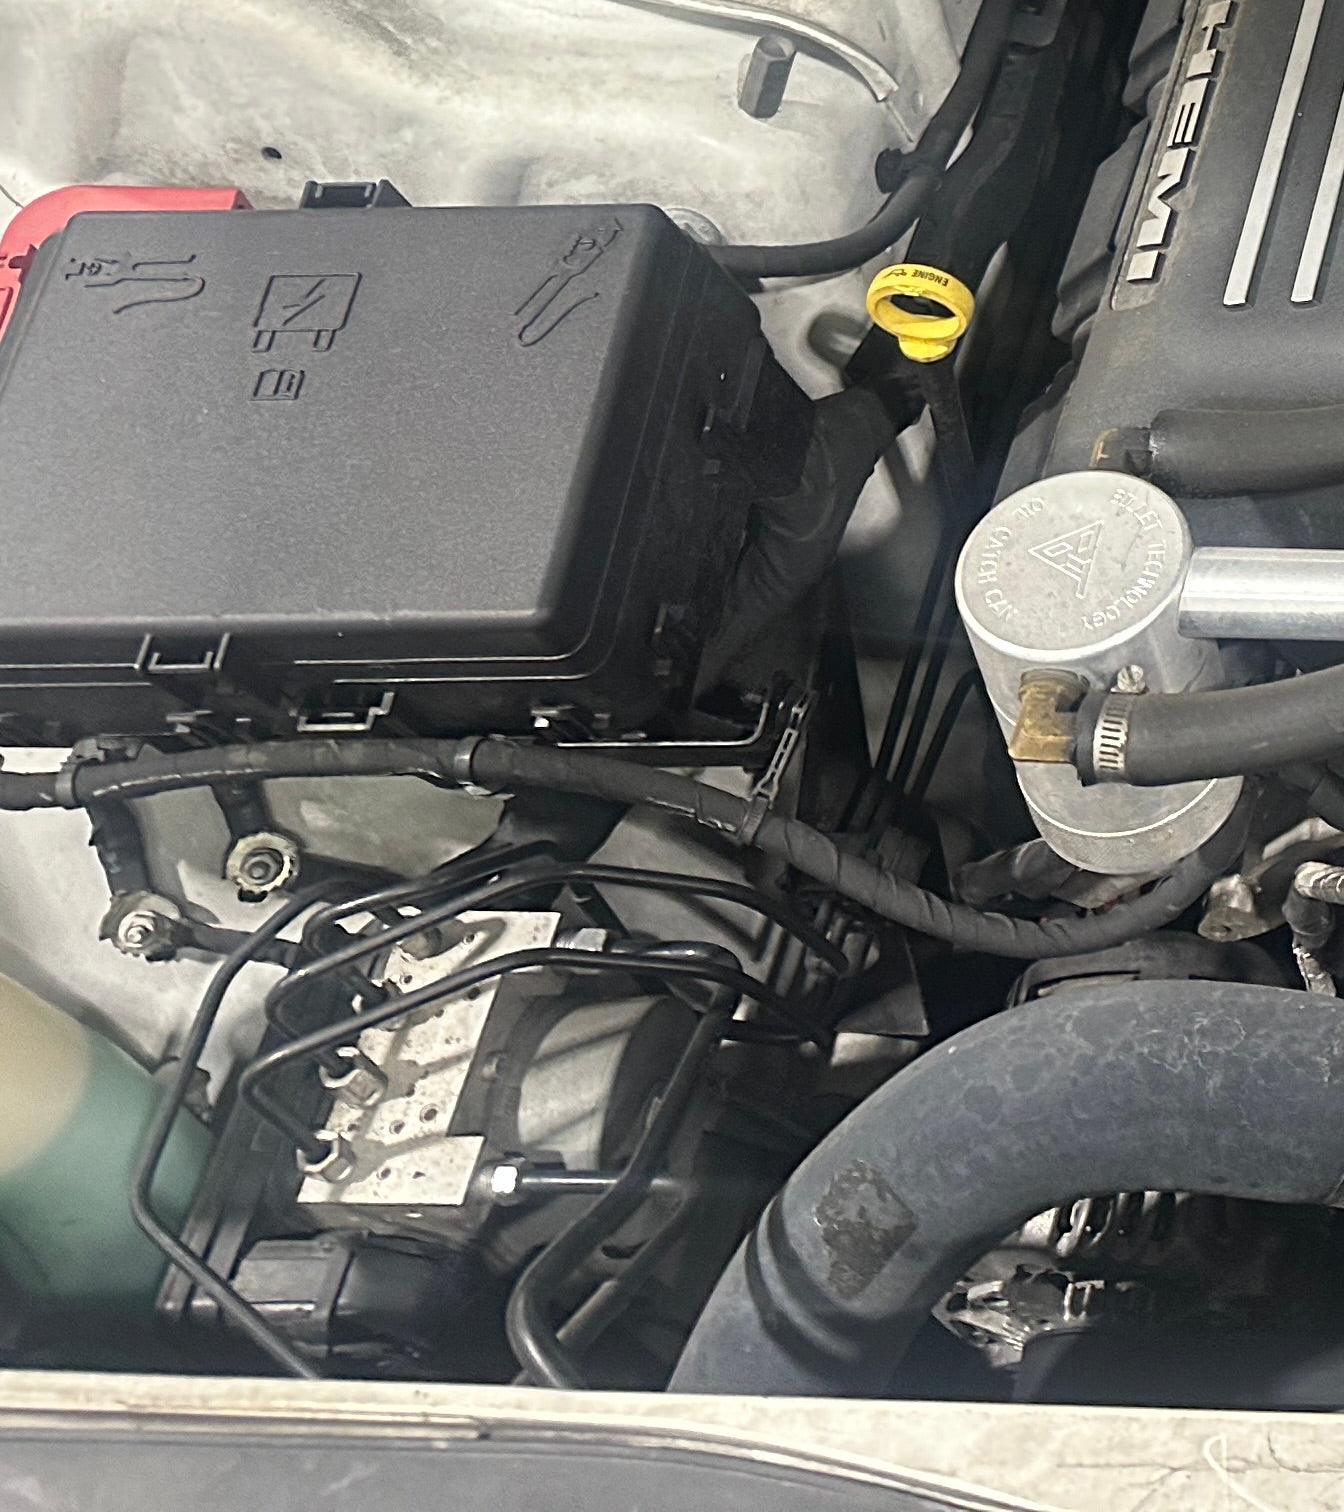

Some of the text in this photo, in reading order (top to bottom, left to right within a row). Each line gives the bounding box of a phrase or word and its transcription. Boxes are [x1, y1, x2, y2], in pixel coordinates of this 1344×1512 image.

[911, 269, 949, 287] ENGINE
[1011, 496, 1046, 520] OIL
[978, 525, 1012, 585] CATCH
[1081, 539, 1167, 630] TECHNOLOGY
